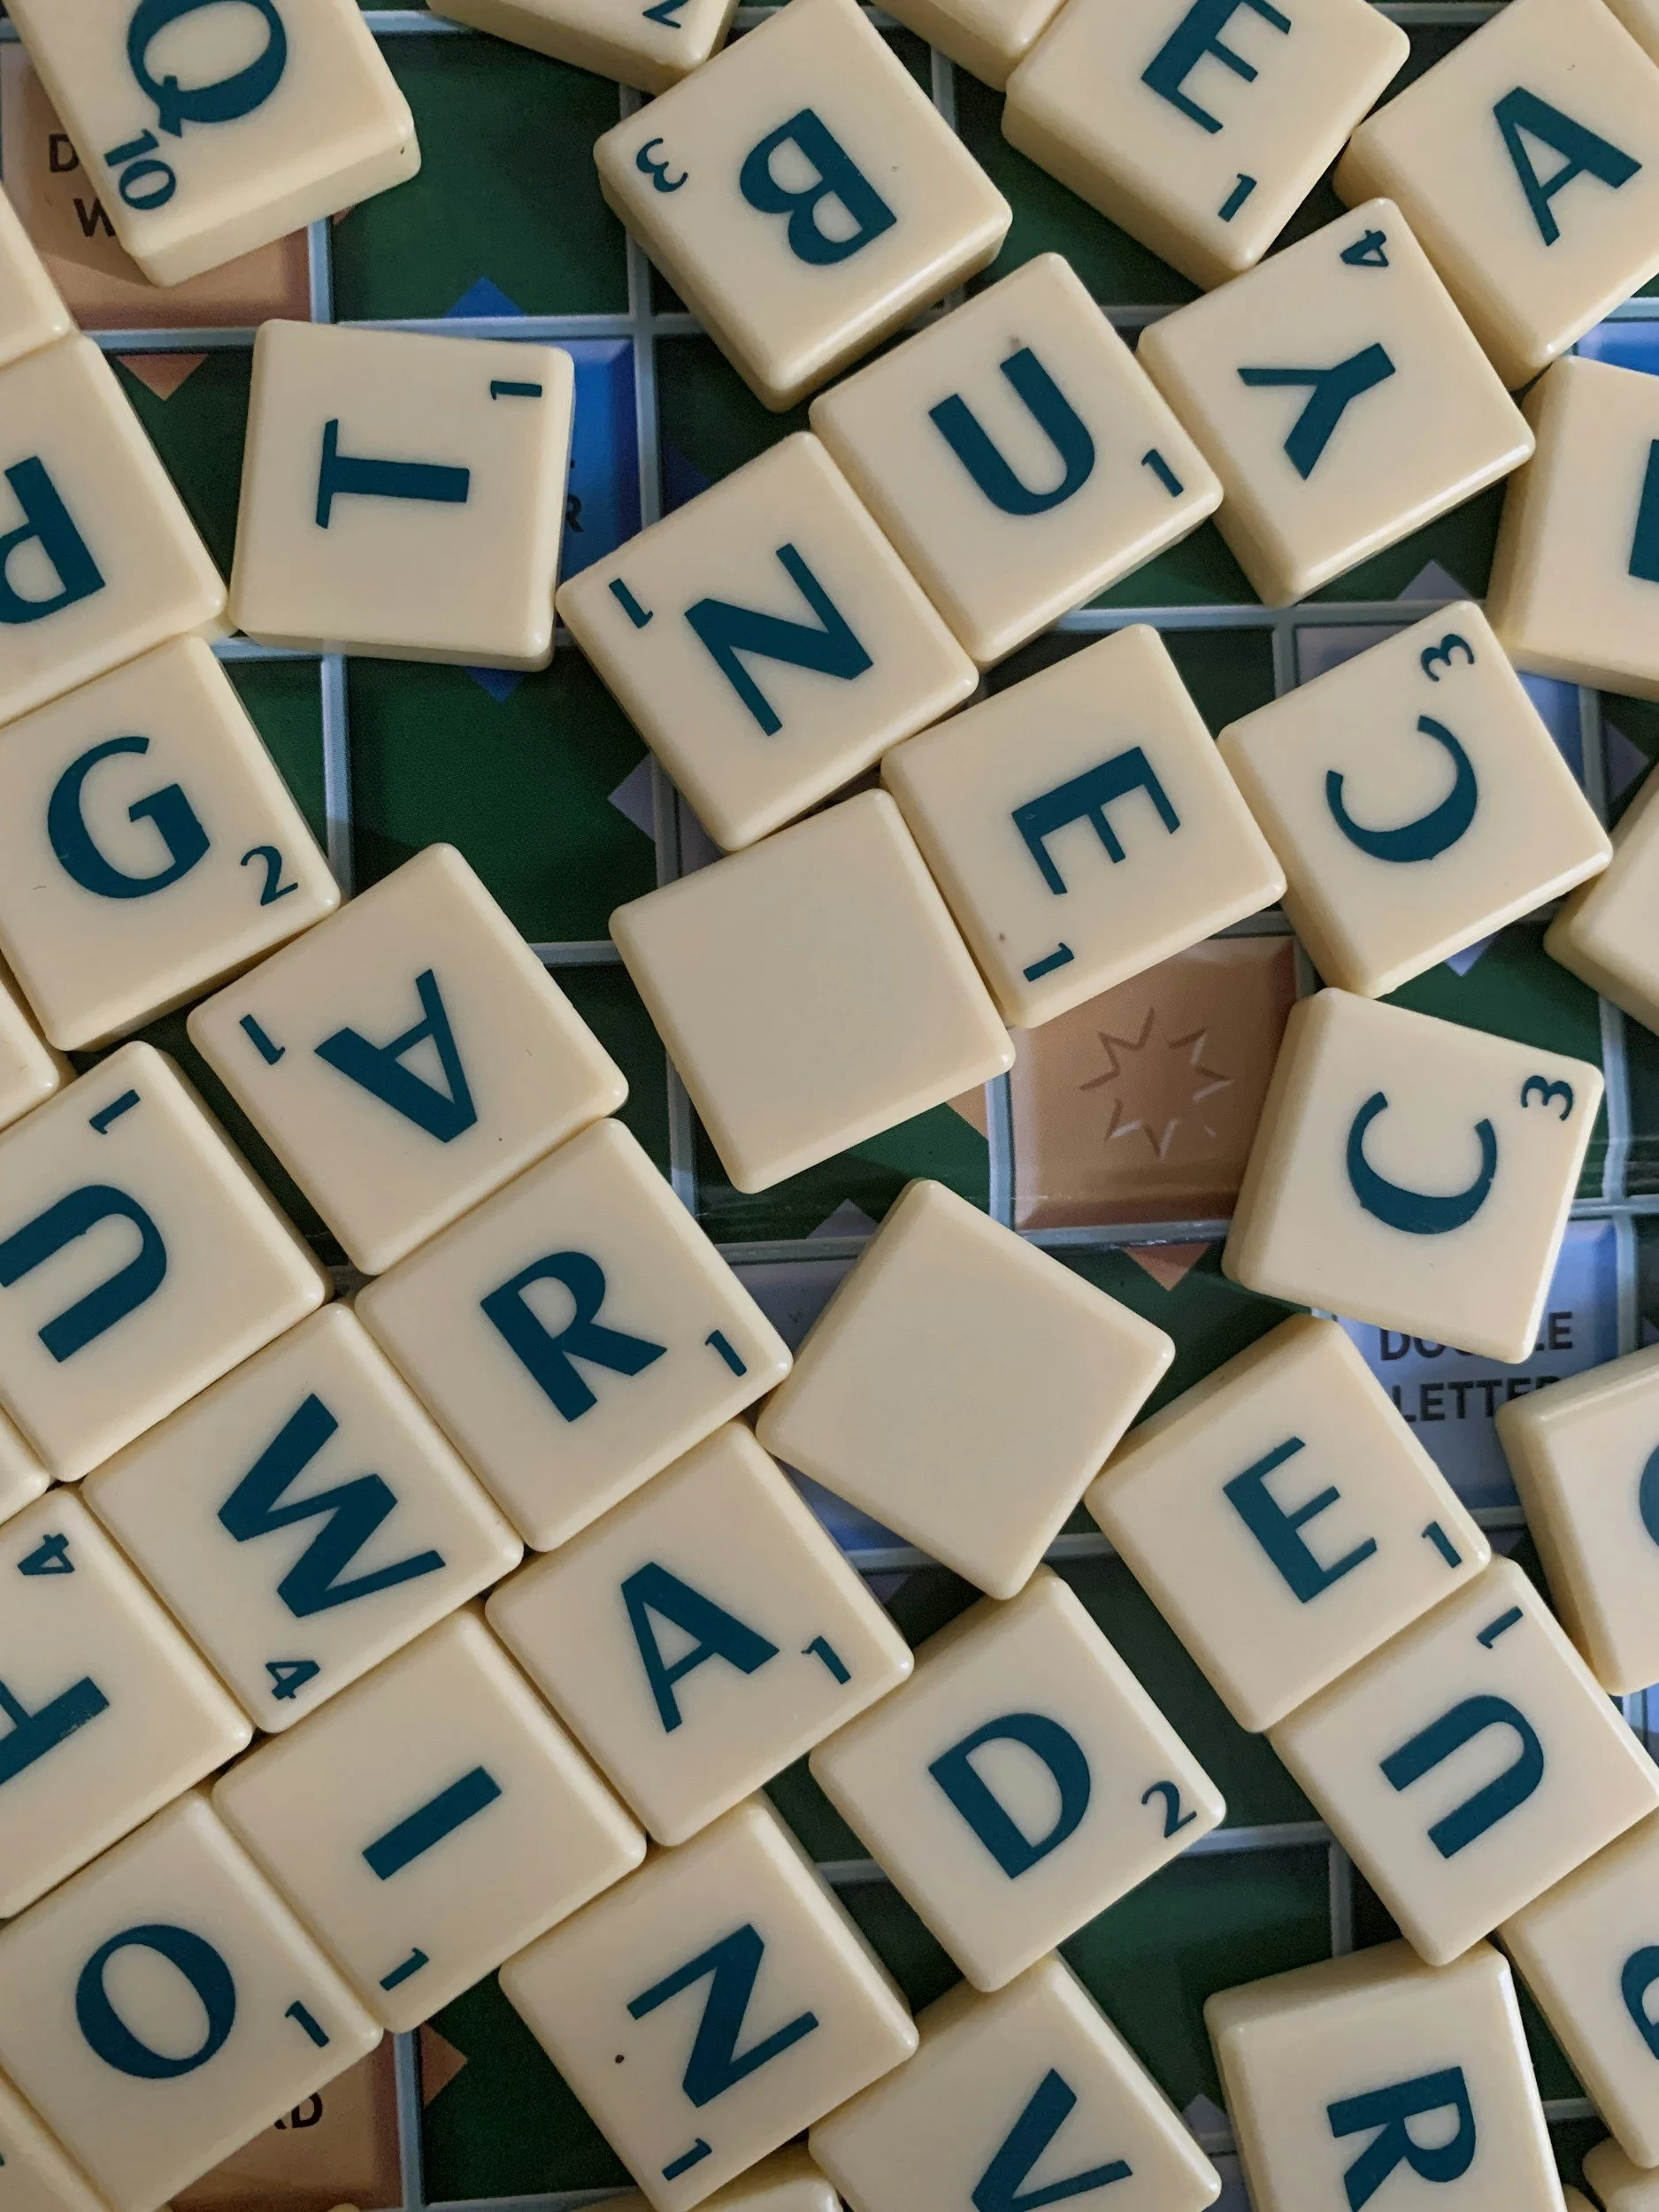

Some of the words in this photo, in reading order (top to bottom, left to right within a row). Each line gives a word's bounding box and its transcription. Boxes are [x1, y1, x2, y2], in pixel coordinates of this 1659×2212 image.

[127, 0, 288, 137] Q
[1142, 0, 1290, 132] E
[104, 128, 176, 211] 10
[636, 138, 687, 192] 3
[741, 109, 896, 265] B
[1218, 174, 1256, 221] 1
[1494, 88, 1640, 246] A
[1340, 230, 1388, 267] 4
[490, 380, 542, 398] 1
[930, 348, 1095, 516] U
[1238, 343, 1395, 480] Y
[316, 419, 470, 529] T
[1142, 449, 1184, 497] 1
[609, 579, 653, 628] 1
[684, 544, 873, 736] N
[1420, 633, 1475, 682] 3
[47, 736, 211, 899] G
[1012, 746, 1179, 895] E
[1326, 715, 1478, 863] C
[241, 845, 298, 906] 2
[1023, 942, 1074, 982] 1
[240, 1014, 285, 1064] 1
[315, 969, 478, 1143] A
[89, 1089, 141, 1134] 1
[1521, 1075, 1574, 1121] 3
[1347, 1092, 1497, 1234] C
[0, 1185, 167, 1363] U
[481, 1250, 667, 1423] R
[705, 1330, 747, 1377] 1
[18, 1533, 74, 1576] 4
[218, 1393, 446, 1618] W
[1224, 1436, 1377, 1603] E
[1422, 1521, 1462, 1568] 1
[265, 1659, 321, 1700] 4
[621, 1562, 780, 1732] A
[802, 1635, 851, 1684] 1
[1477, 1607, 1524, 1649] 1
[363, 1766, 503, 1880] I
[928, 1712, 1091, 1879] D
[1141, 1779, 1197, 1838] 2
[1380, 1694, 1544, 1859] U
[76, 1924, 236, 2079] O
[285, 2000, 330, 2048] 1
[380, 1947, 429, 1992] 1
[627, 1924, 819, 2108] N
[663, 2138, 712, 2181] 1
[972, 2068, 1133, 2212] V
[1326, 2066, 1476, 2212] R
